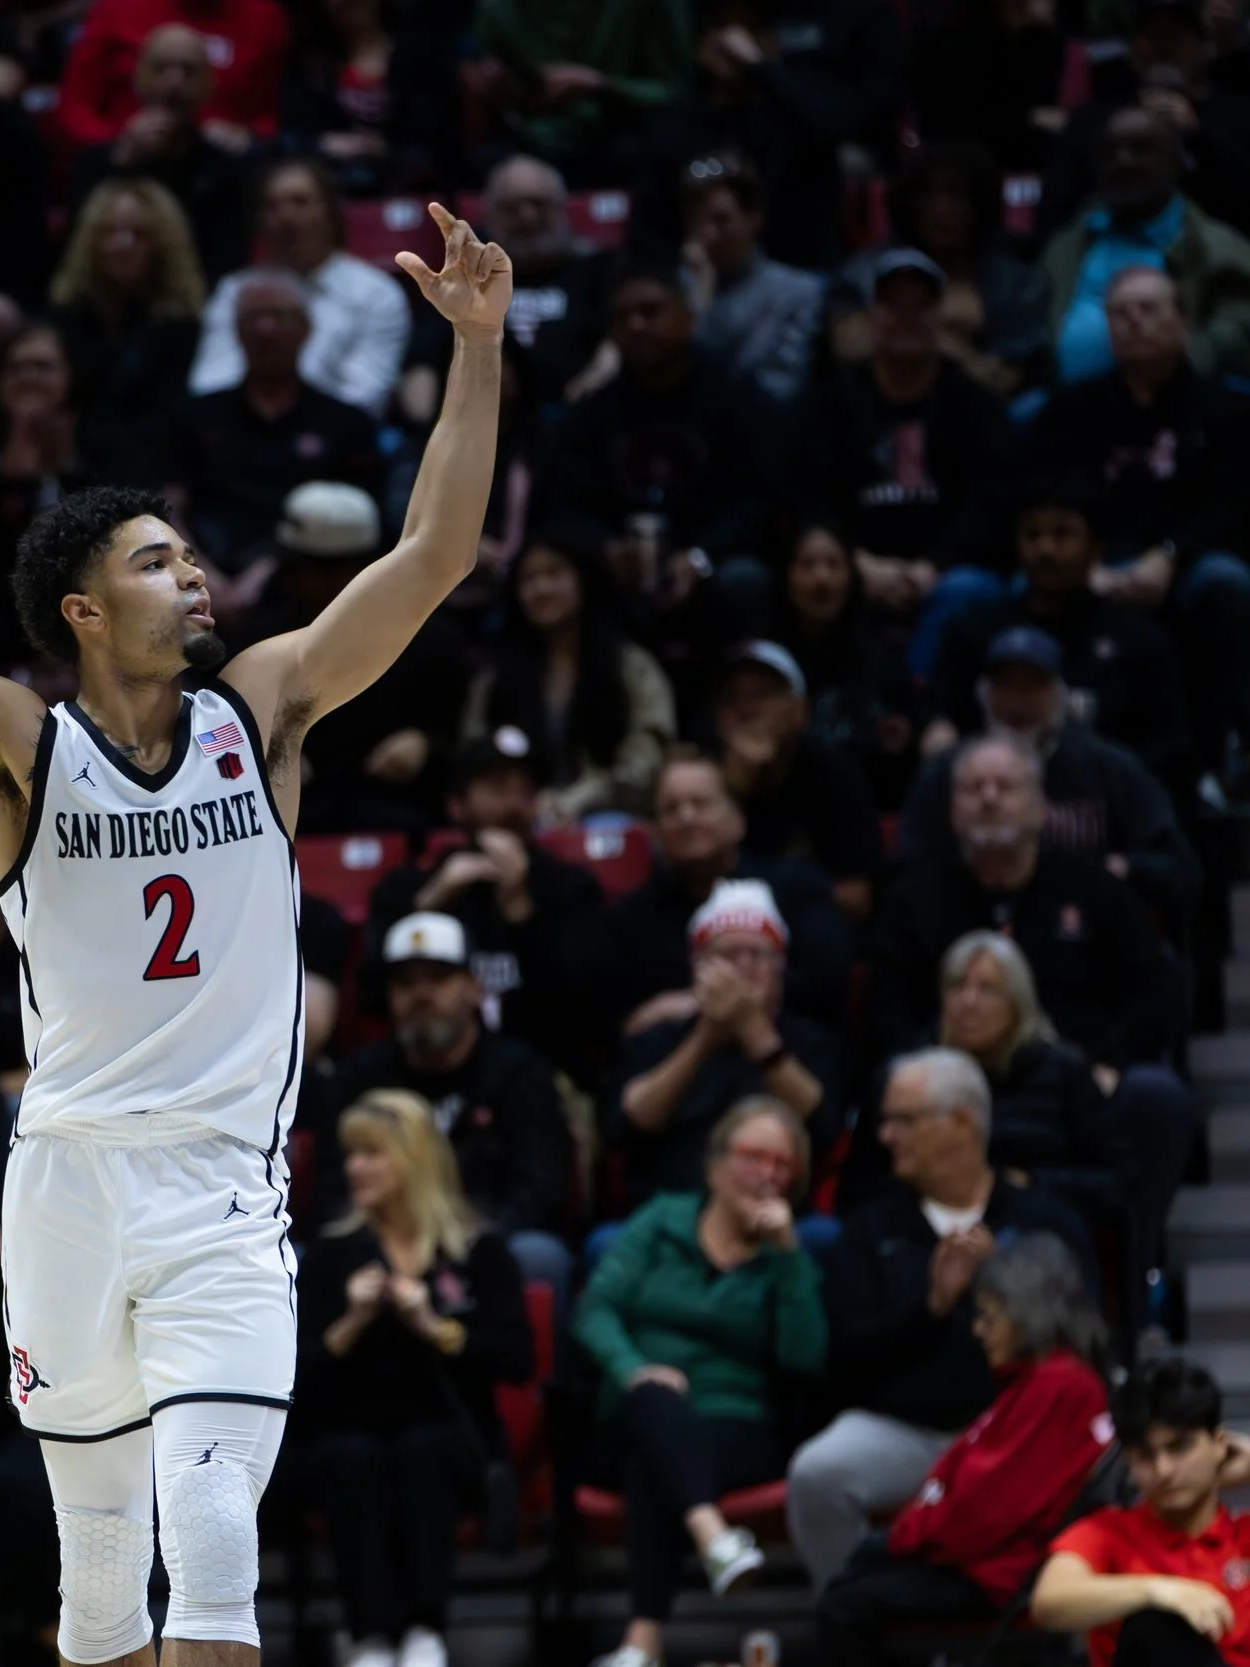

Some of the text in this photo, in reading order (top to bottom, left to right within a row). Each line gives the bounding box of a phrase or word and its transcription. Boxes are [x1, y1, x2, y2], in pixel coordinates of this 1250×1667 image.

[55, 791, 263, 859] SAN DIEGO STATE
[143, 874, 200, 981] 2
